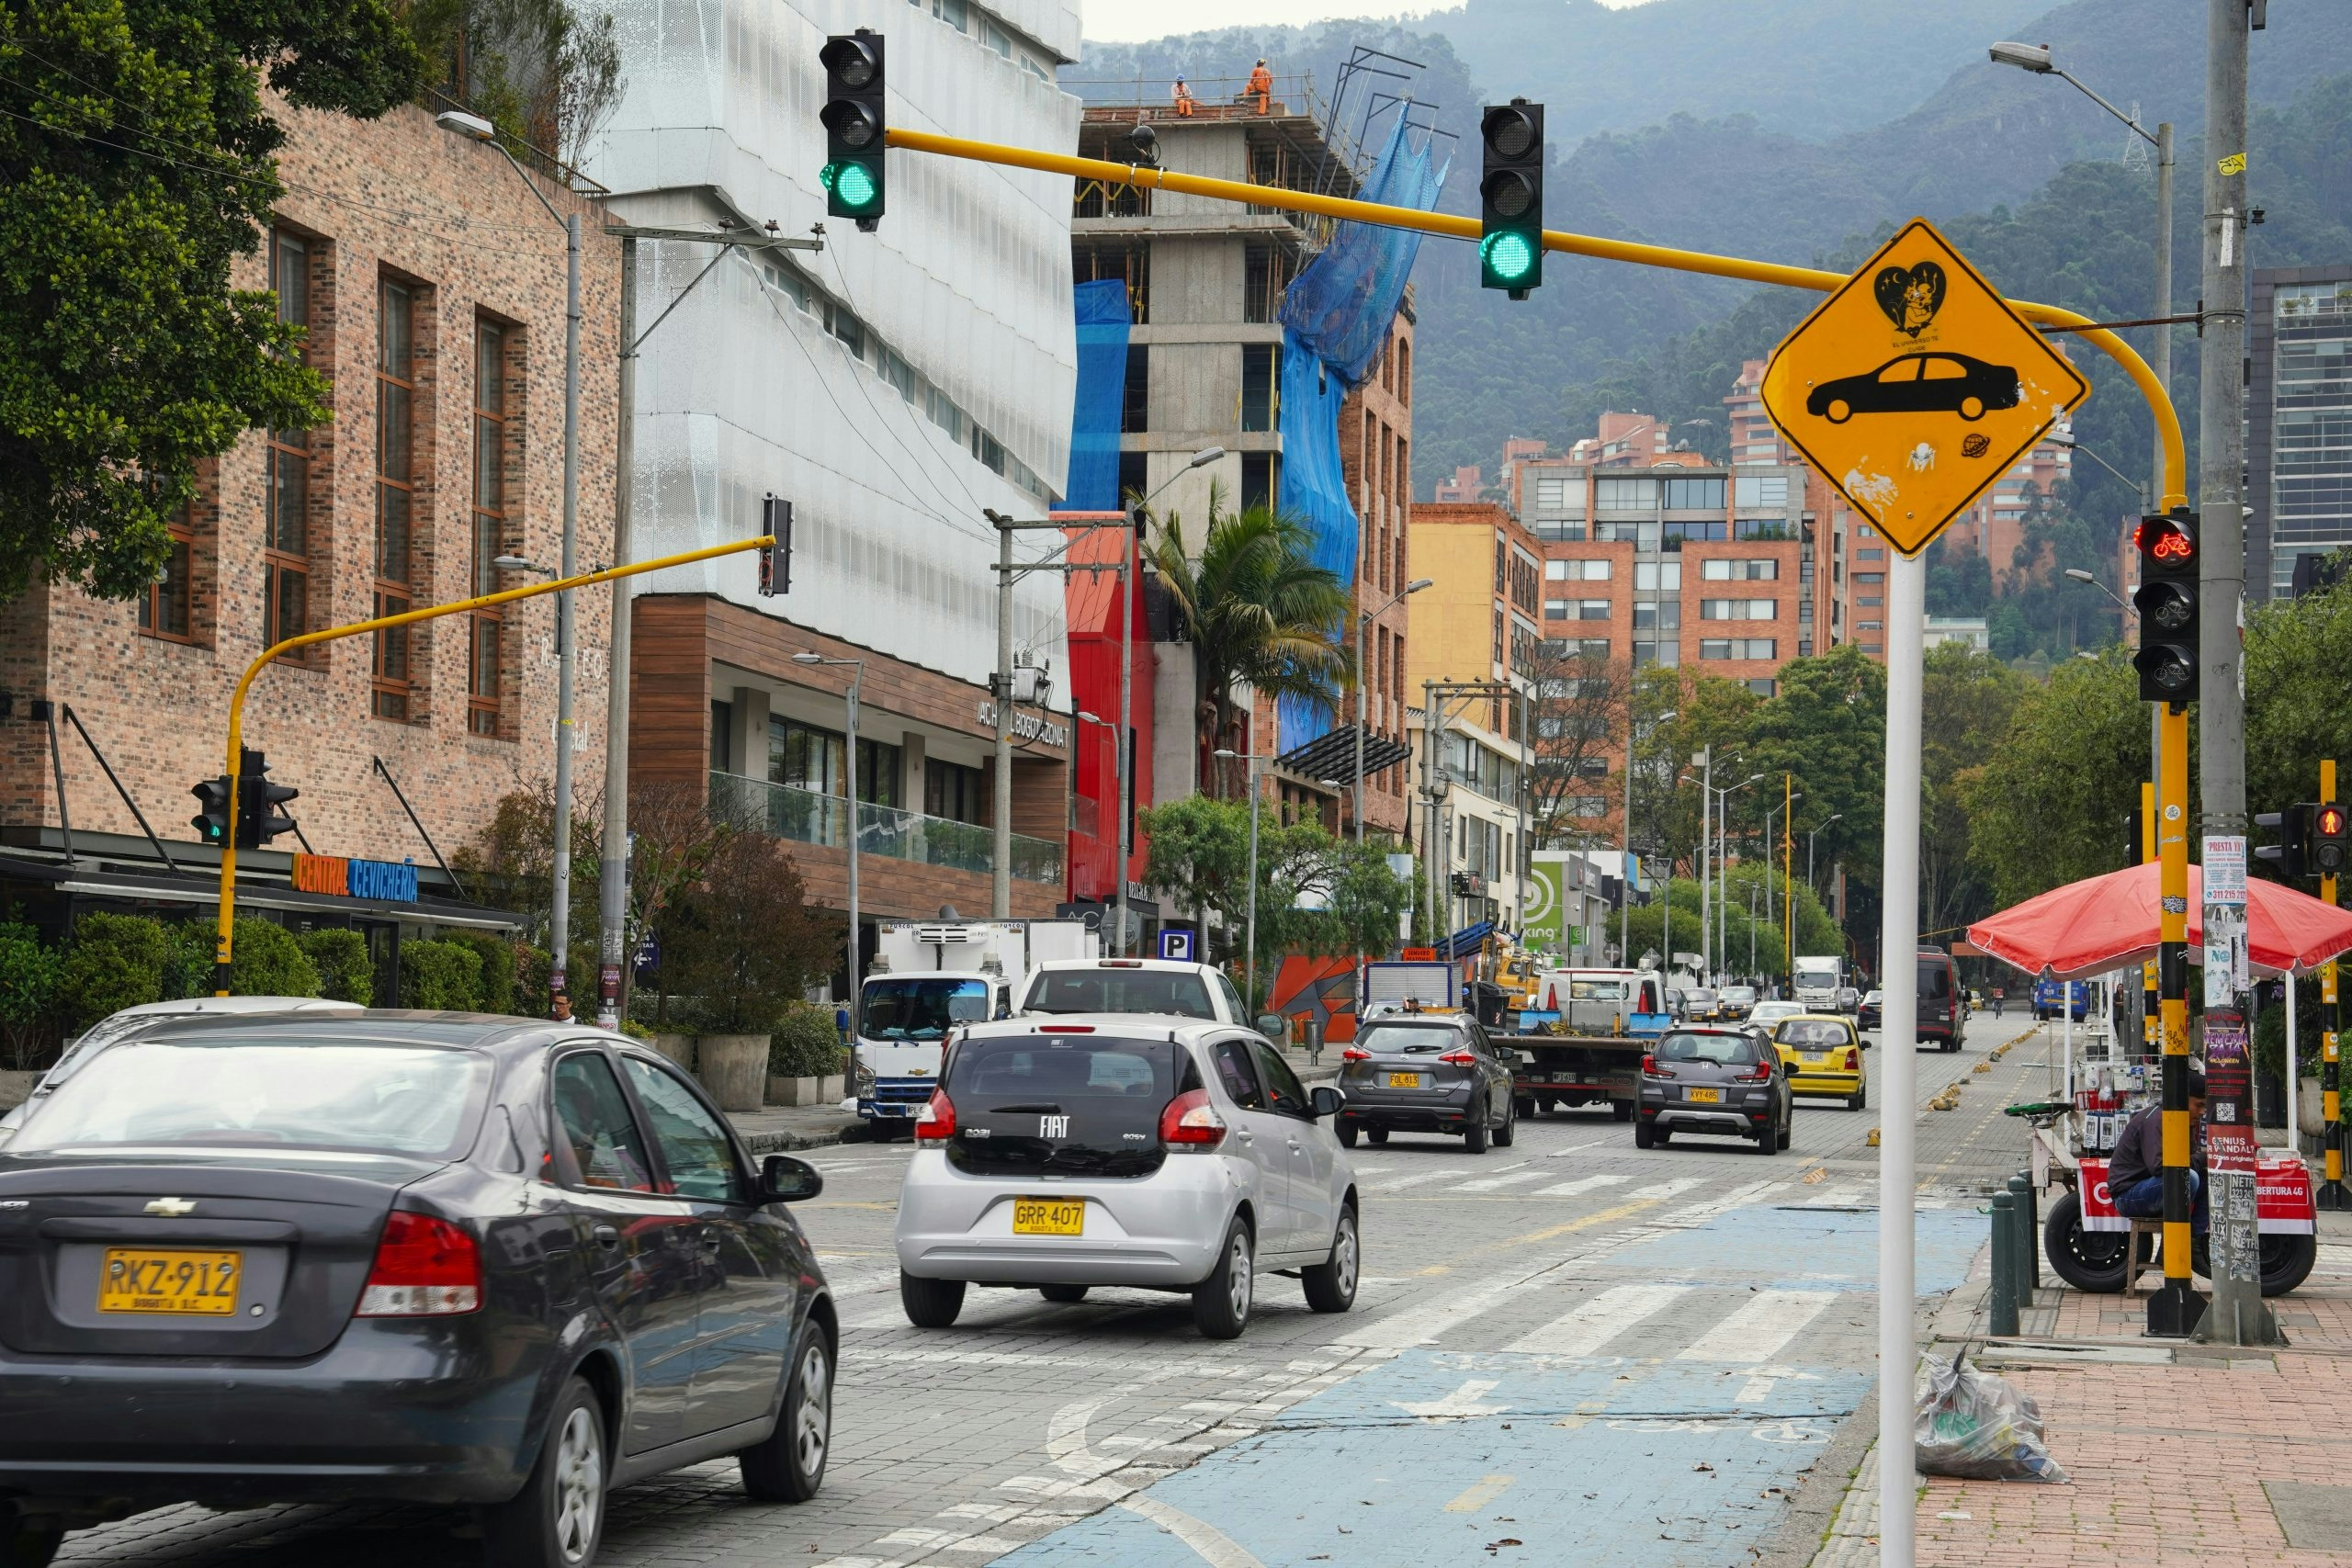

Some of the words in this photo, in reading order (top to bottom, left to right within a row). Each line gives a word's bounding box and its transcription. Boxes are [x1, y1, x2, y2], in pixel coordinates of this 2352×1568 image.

[978, 701, 990, 726] AC
[1045, 722, 1064, 748] ZONA
[299, 853, 349, 897] CENTRAL
[354, 857, 418, 903] CEVICHERÍA
[2212, 890, 2223, 899] 311
[2224, 890, 2236, 899] 215
[1167, 935, 1185, 957] P
[1039, 1115, 1070, 1138] FIAT
[2293, 1186, 2303, 1196] 4G
